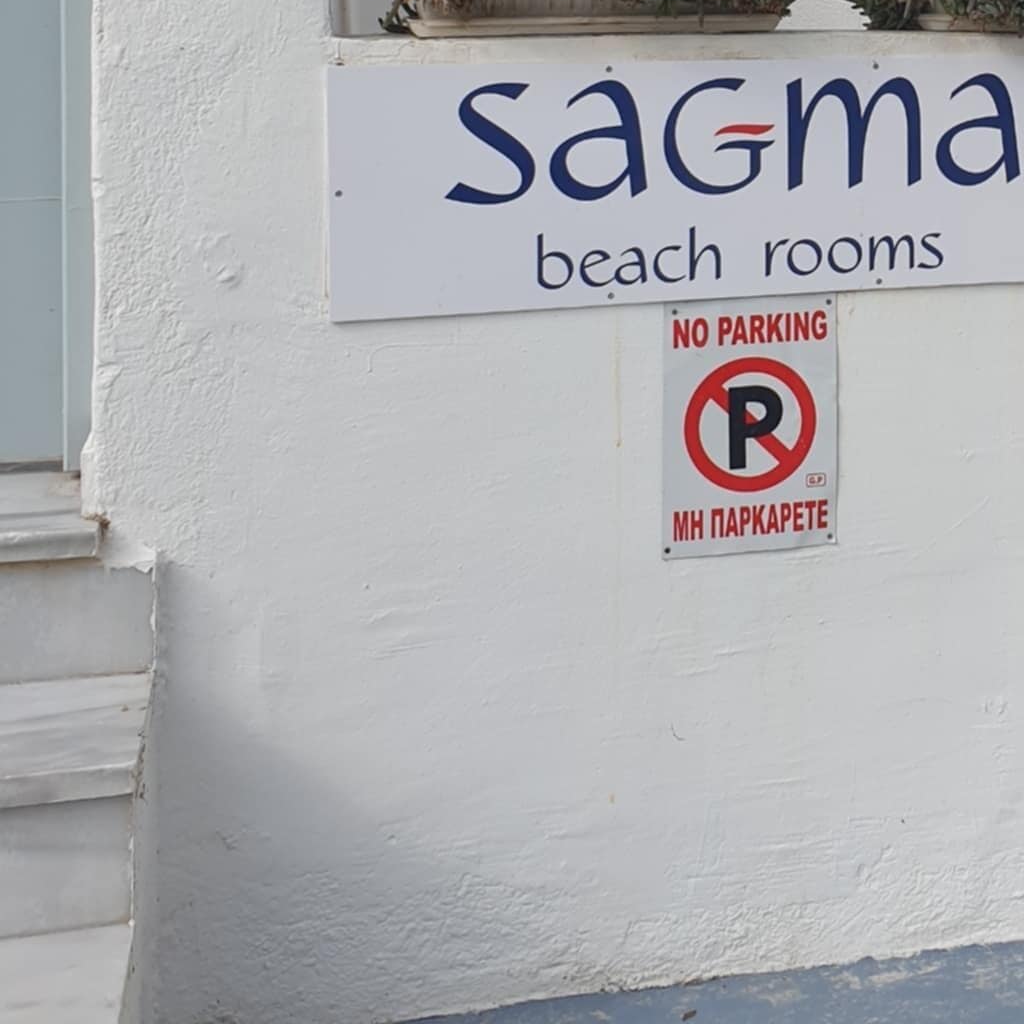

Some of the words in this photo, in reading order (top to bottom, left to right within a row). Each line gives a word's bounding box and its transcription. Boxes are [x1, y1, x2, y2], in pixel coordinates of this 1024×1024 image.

[536, 226, 722, 291] beach
[764, 232, 943, 277] rooms
[672, 317, 709, 349] NO
[716, 309, 828, 346] PARKING
[672, 510, 704, 542] ΜΗ
[710, 499, 828, 539] ΠΑΡΚΑΡΕΤΕ
